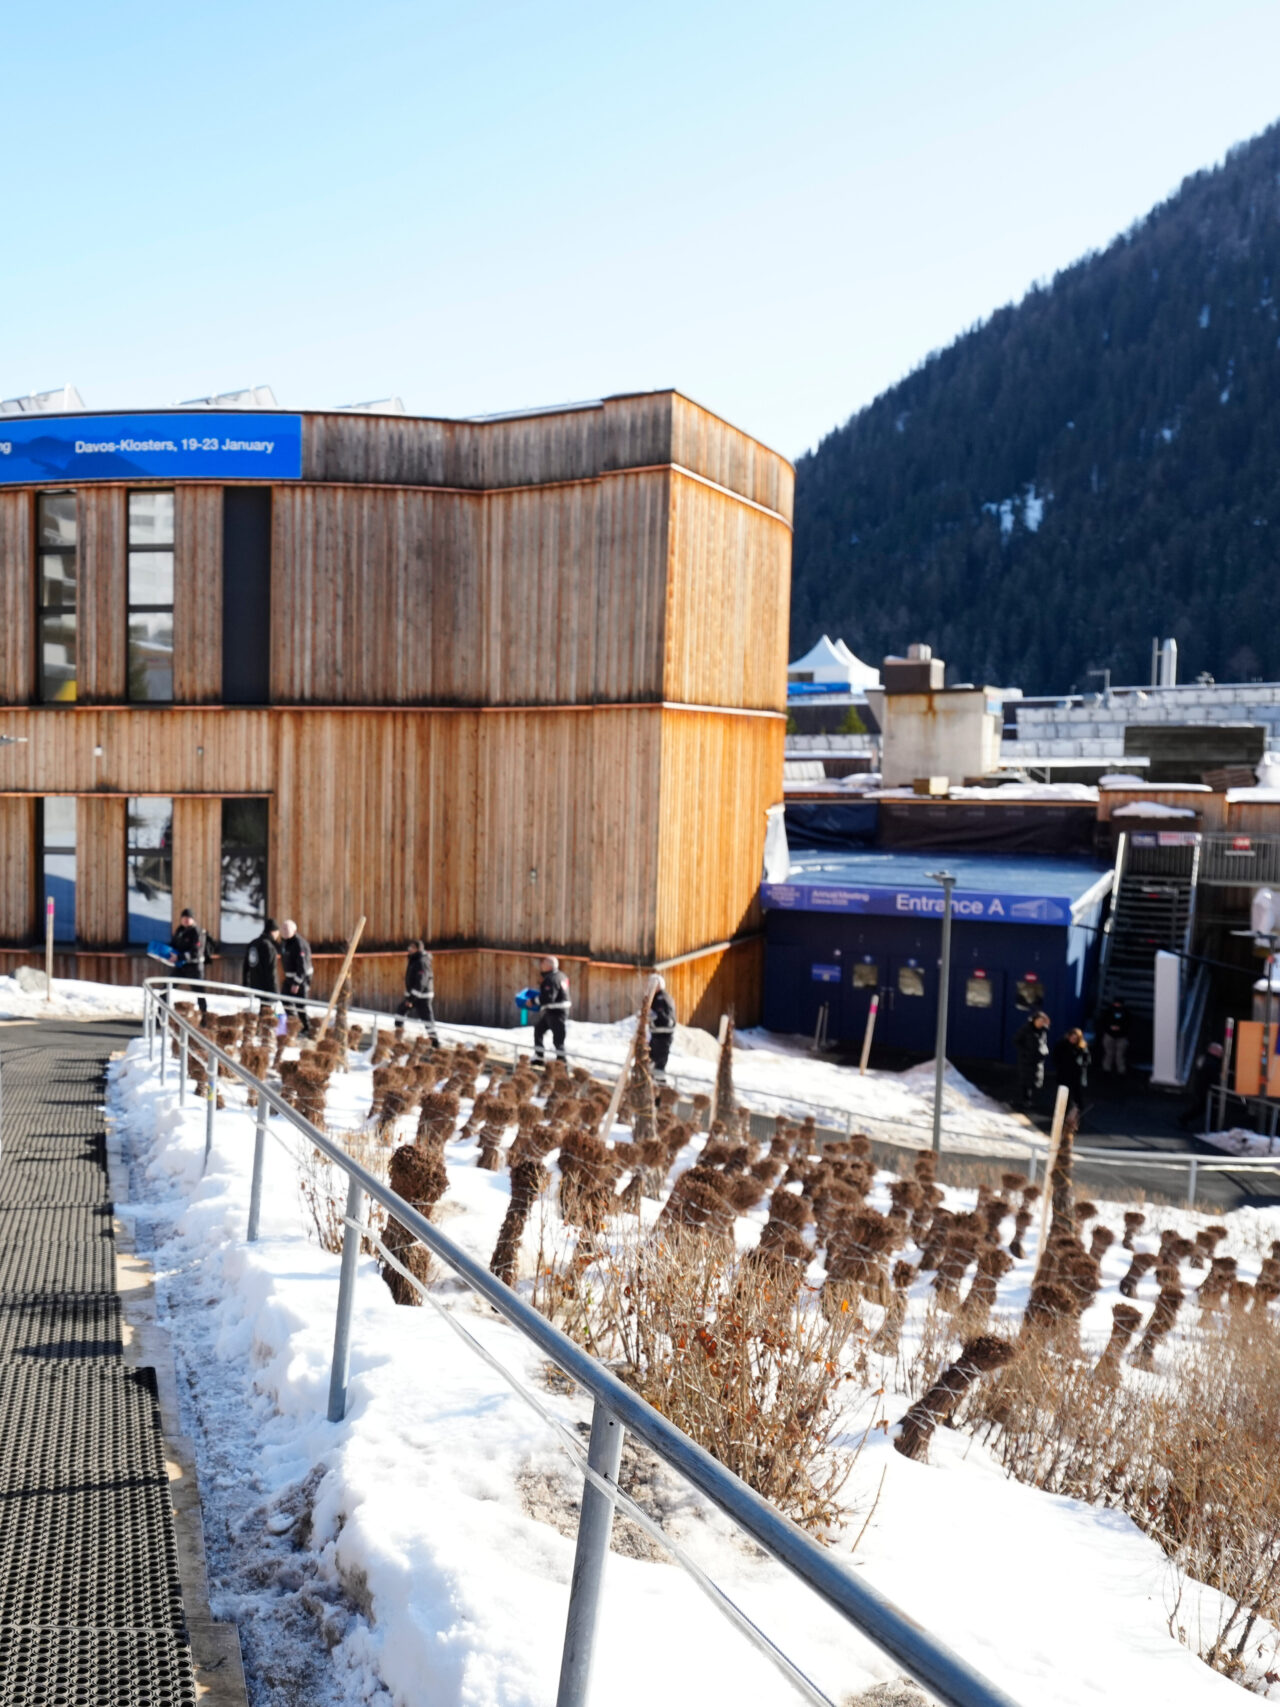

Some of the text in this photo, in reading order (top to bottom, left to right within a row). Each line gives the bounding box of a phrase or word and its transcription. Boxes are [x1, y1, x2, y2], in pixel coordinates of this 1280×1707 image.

[75, 438, 274, 454] Davos-Klosters, 19-23 January
[896, 893, 1005, 916] Entrance A
